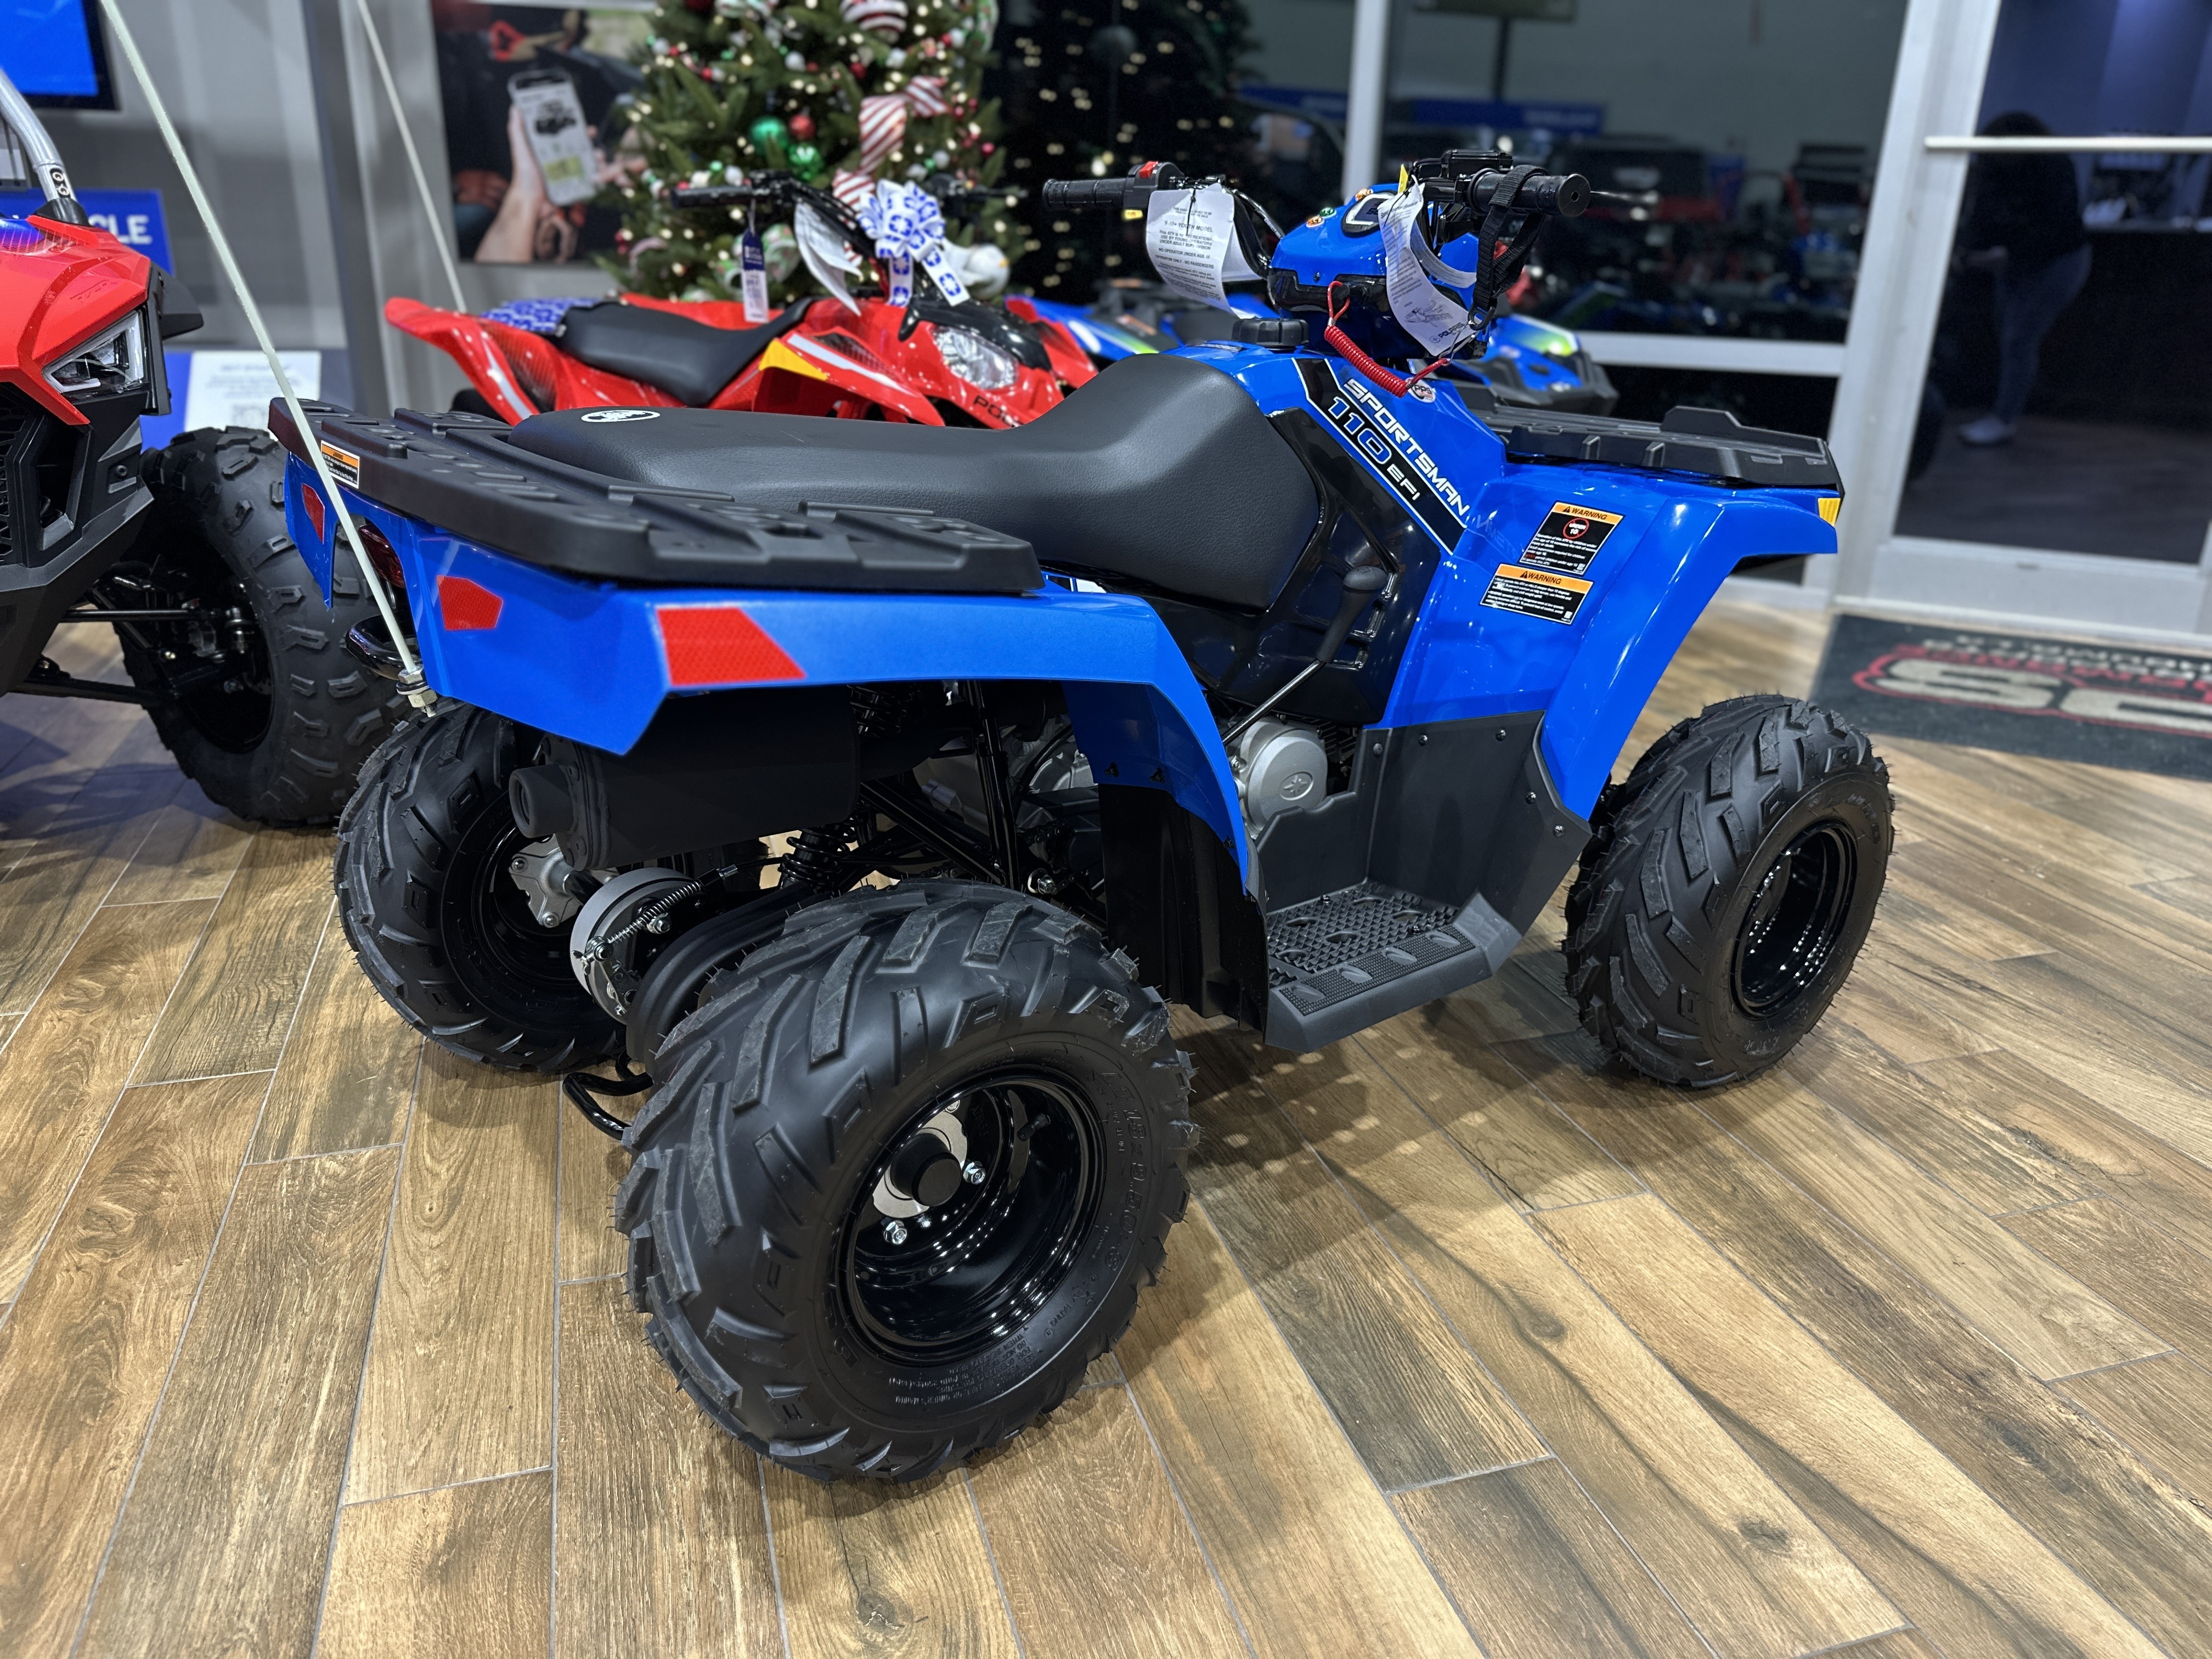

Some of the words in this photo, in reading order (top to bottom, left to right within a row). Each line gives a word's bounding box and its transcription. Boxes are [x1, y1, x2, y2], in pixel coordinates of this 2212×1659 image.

[1328, 396, 1392, 465] 110
[1386, 463, 1420, 500] EFI
[1343, 378, 1470, 516] SPORTSMAN
[1571, 507, 1608, 520] WARNING
[1528, 572, 1562, 585] WARNING
[1003, 1333, 1023, 1350] WHEN
